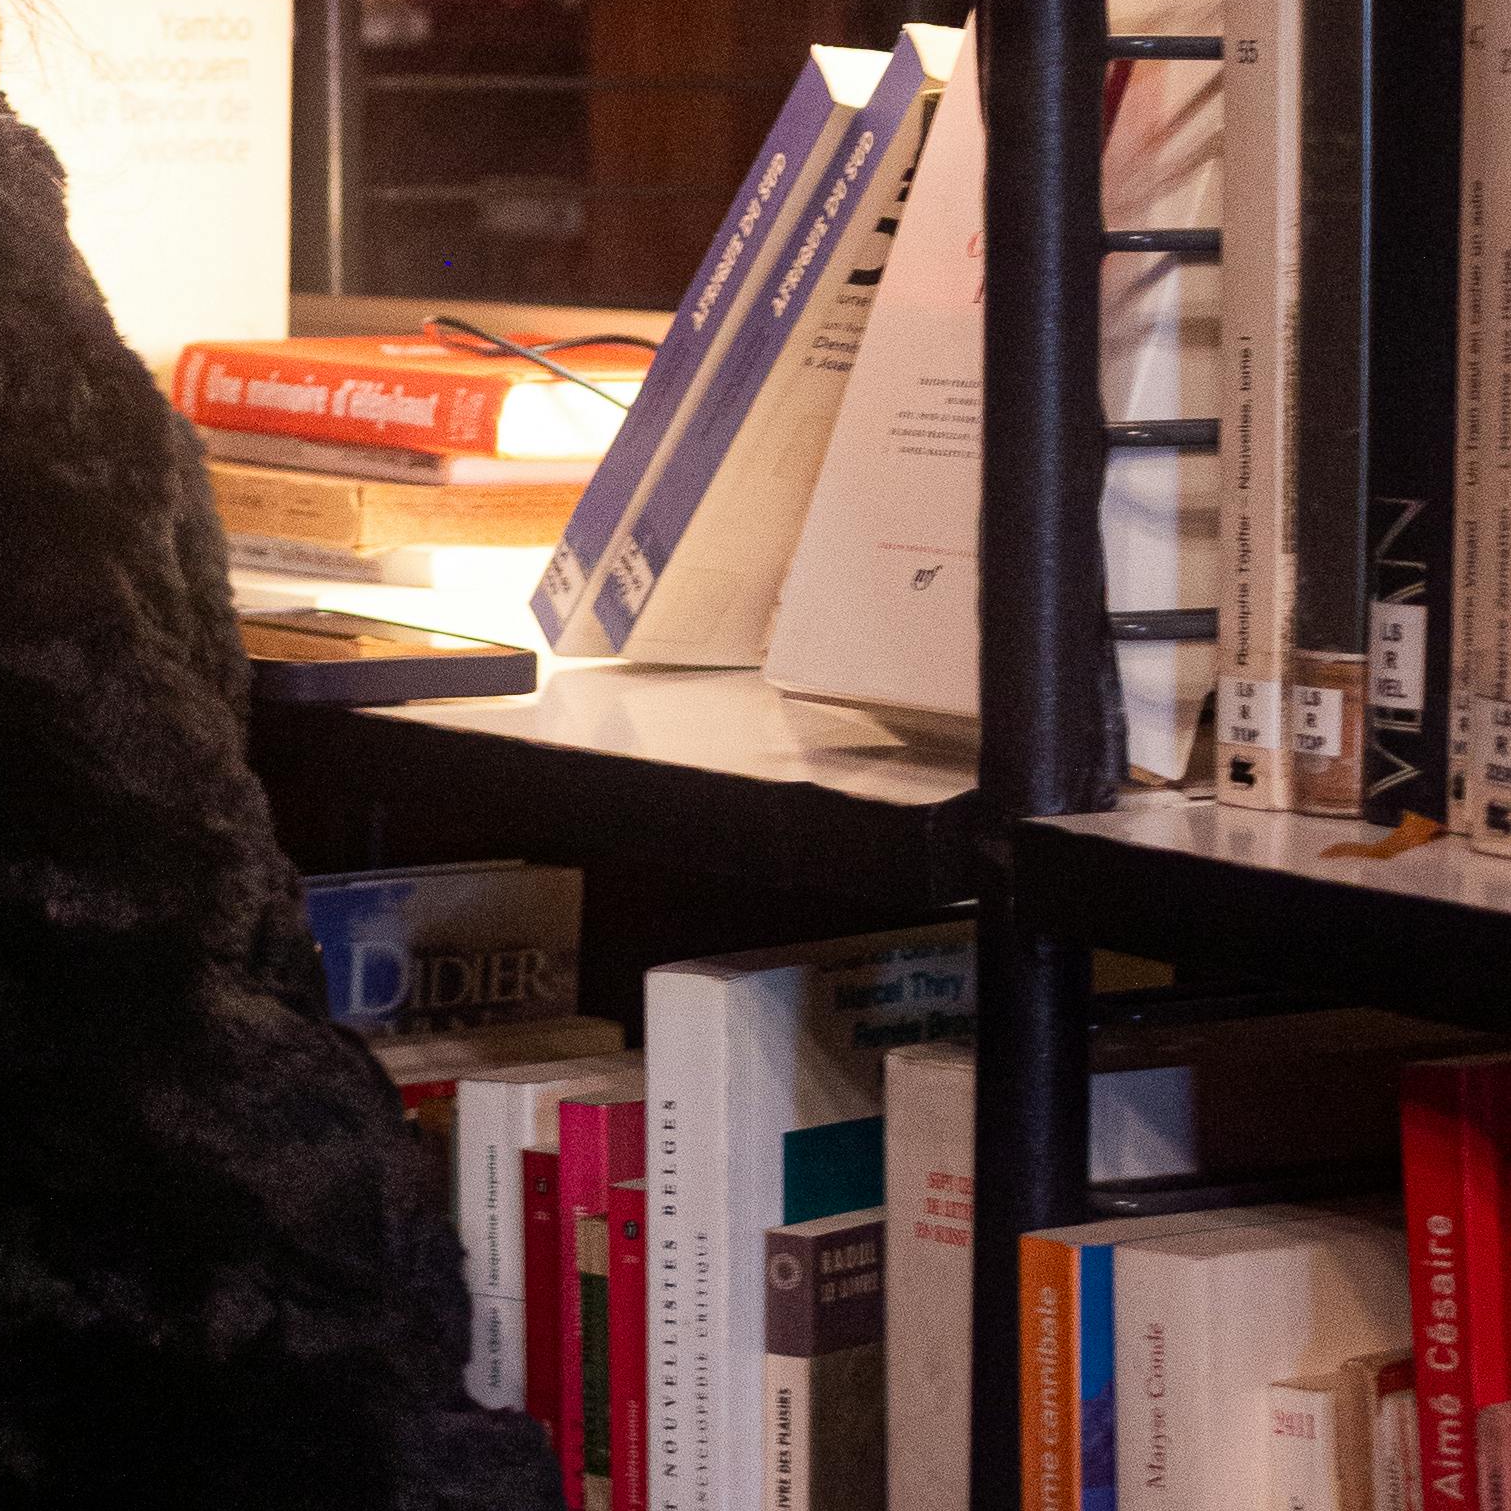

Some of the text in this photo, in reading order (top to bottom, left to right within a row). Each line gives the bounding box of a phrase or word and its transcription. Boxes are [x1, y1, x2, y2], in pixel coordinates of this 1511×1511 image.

[157, 9, 255, 42] Yambo
[690, 153, 787, 332] AFRIQUE DU SUD
[769, 131, 875, 319] AFRIQUE DU SUD
[206, 364, 243, 405] Une
[1236, 347, 1253, 393] tome
[1235, 584, 1254, 668] Rodolphe
[1381, 625, 1403, 644] LS
[1385, 650, 1399, 670] R
[1235, 681, 1255, 699] LS
[1302, 690, 1322, 708] LS
[1295, 732, 1327, 752] TOP
[1305, 712, 1318, 729] R
[346, 939, 560, 1015] DIDIER
[661, 1099, 678, 1216] BELGES
[1424, 1214, 1462, 1374] Césaire
[662, 1239, 679, 1477] NOUVELLISTES
[1034, 1287, 1060, 1444] cannibale
[1143, 1322, 1170, 1492] Maryse Condé
[776, 1449, 792, 1475] DES
